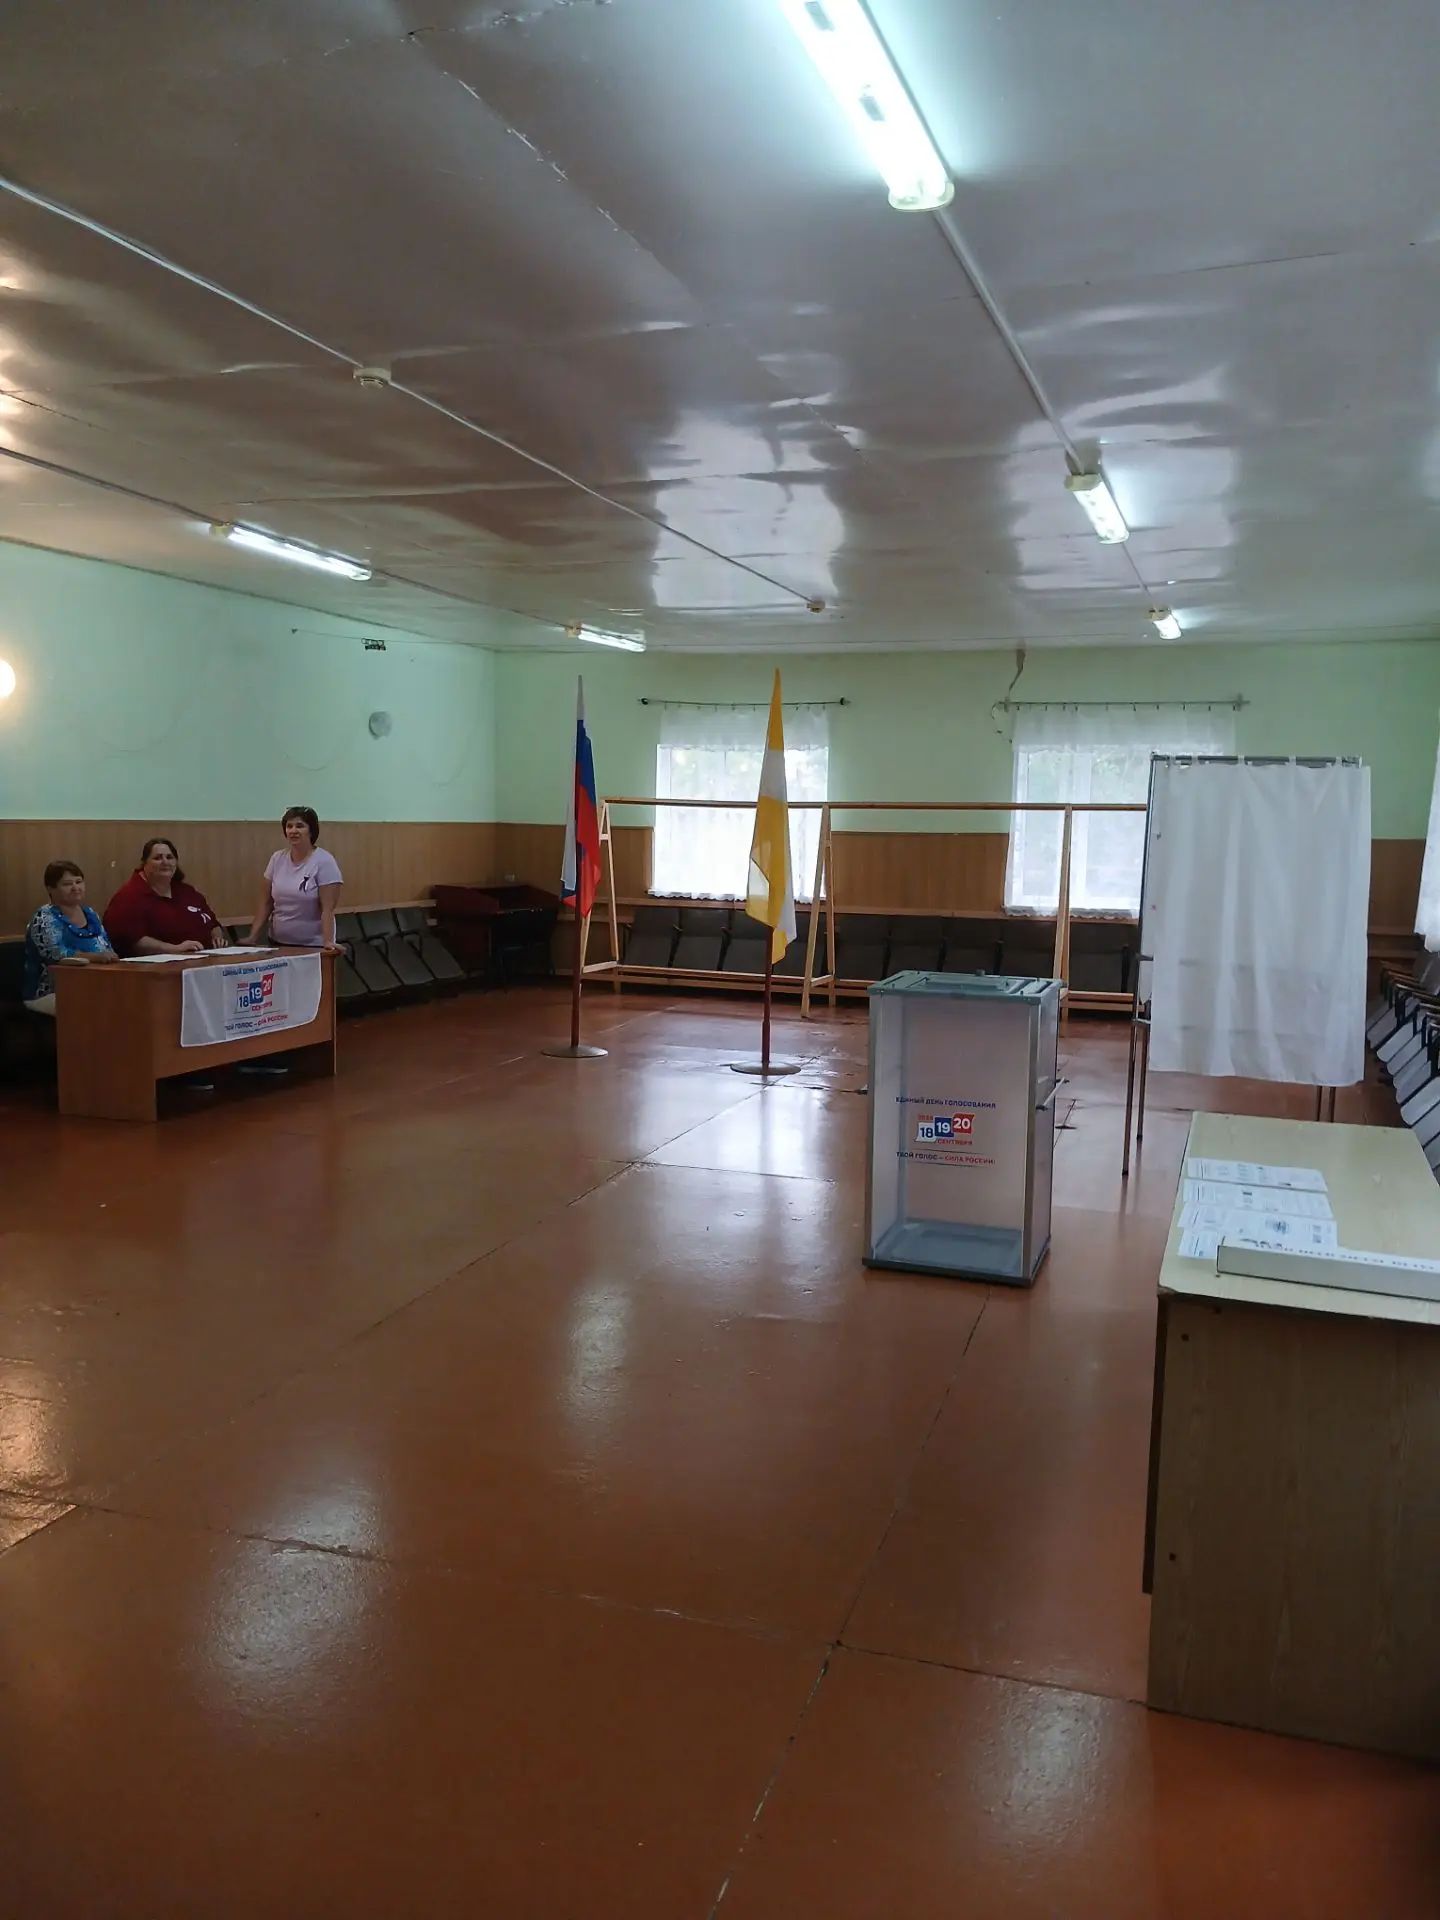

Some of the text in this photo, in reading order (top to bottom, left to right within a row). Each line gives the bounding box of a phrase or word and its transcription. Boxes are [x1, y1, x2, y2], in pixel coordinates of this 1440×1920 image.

[239, 995, 249, 1008] 18
[251, 987, 262, 1000] 19
[263, 979, 272, 992] 20
[896, 1096, 924, 1104] ЕДИНЫЙ
[945, 1099, 996, 1109] ГОЛОСОВАНИЯ
[920, 1117, 971, 1138] 18 19 20
[915, 1152, 938, 1160] ГОЛОС
[945, 1155, 964, 1163] СИЛА
